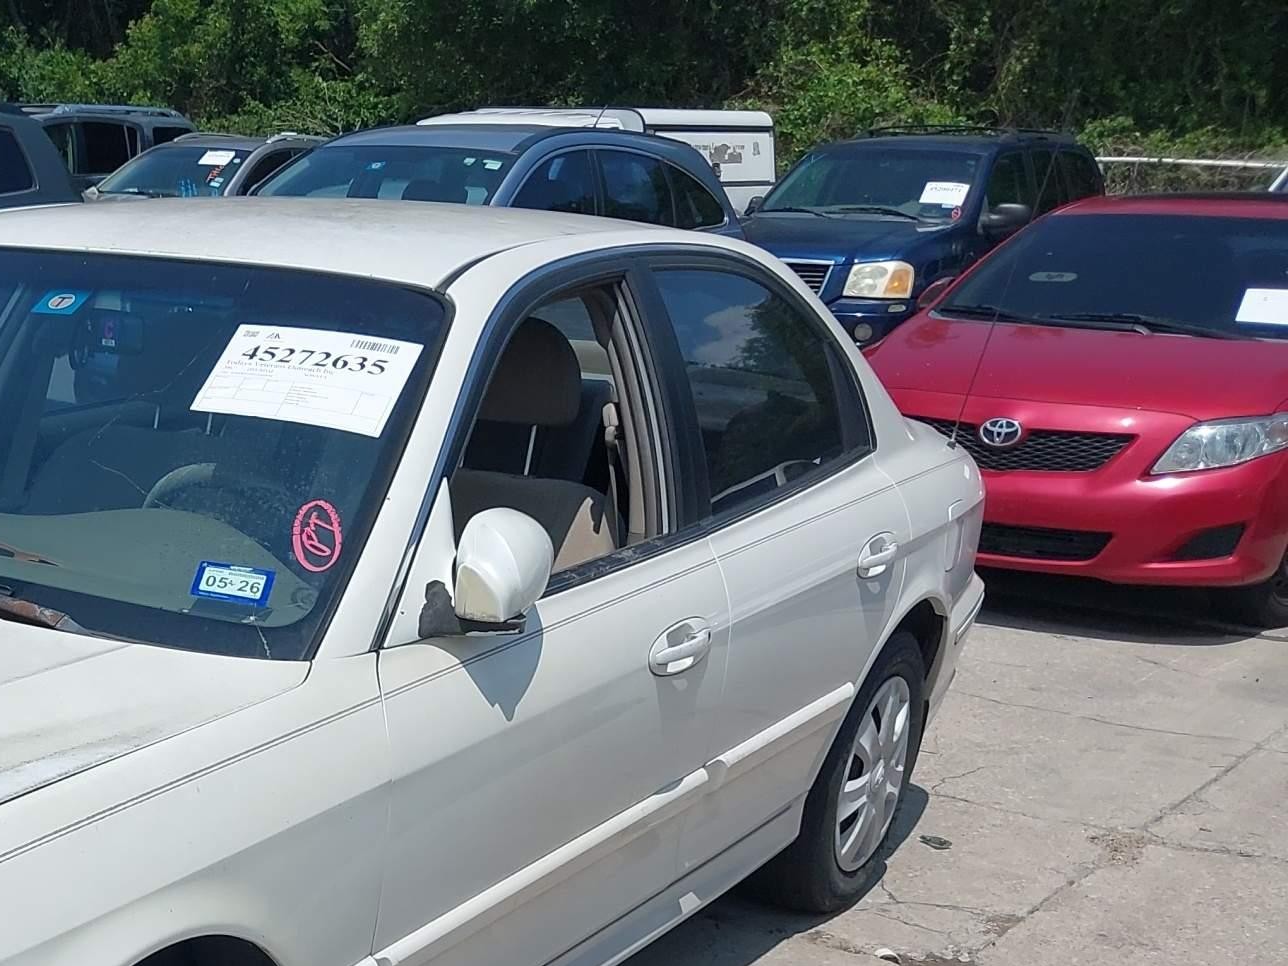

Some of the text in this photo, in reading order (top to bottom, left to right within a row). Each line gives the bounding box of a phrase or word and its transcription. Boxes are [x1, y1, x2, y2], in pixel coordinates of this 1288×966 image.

[241, 344, 390, 376] 45272635
[205, 575, 229, 589] 05
[237, 580, 261, 594] 26
